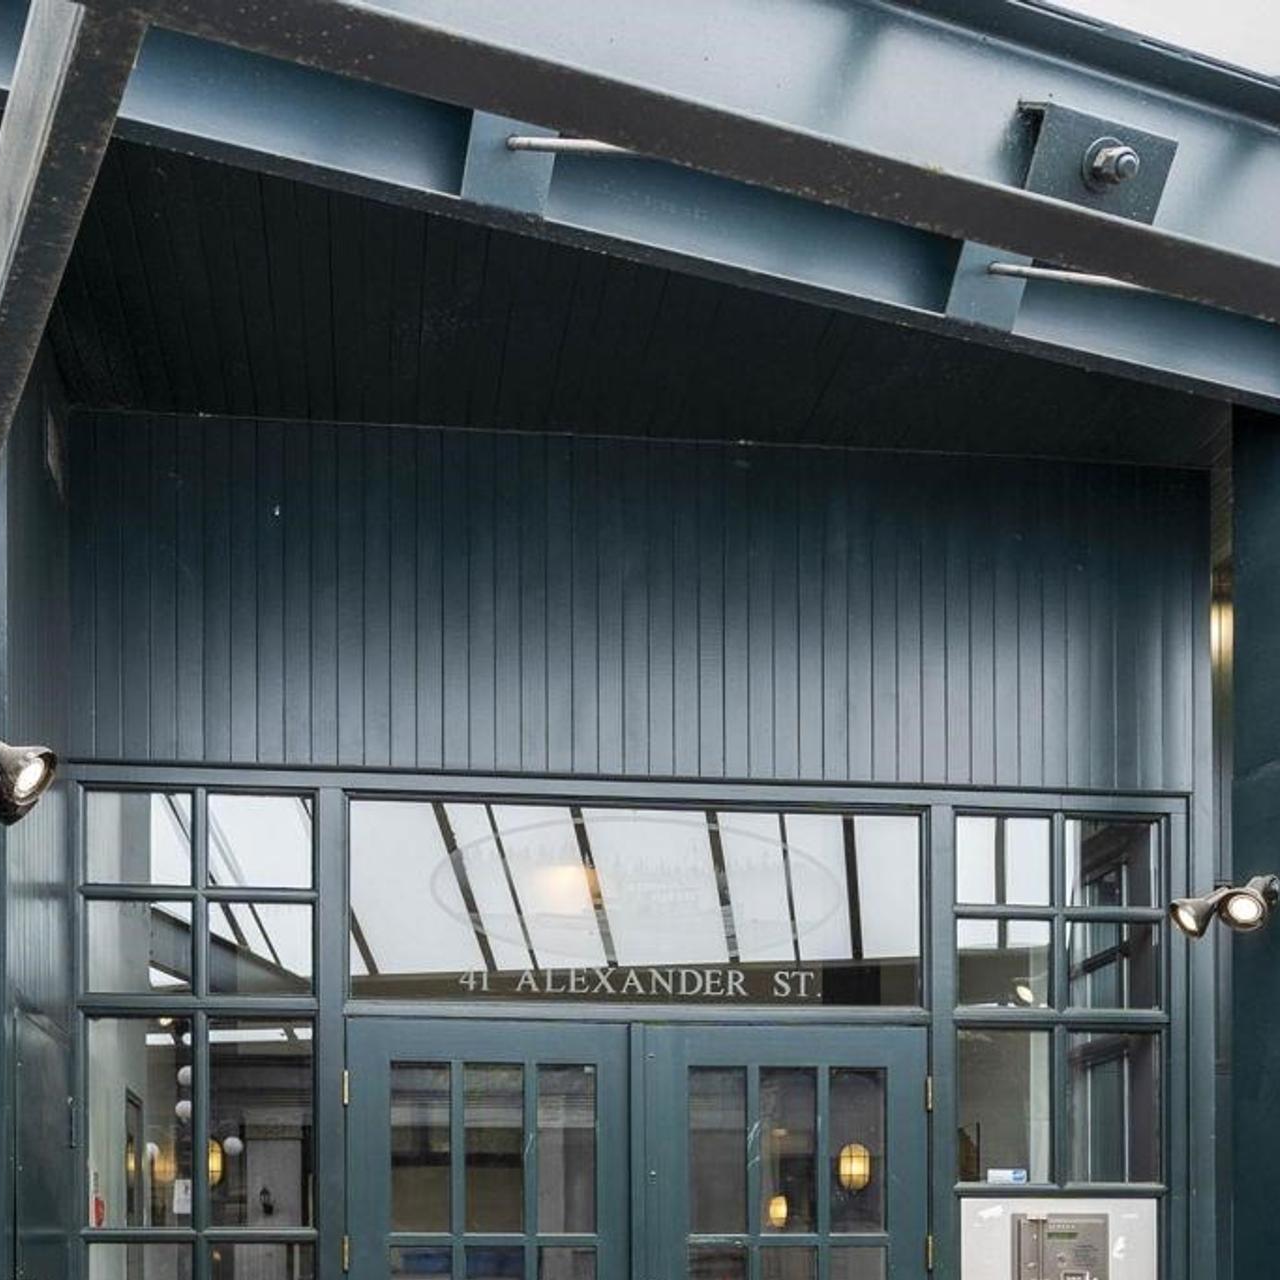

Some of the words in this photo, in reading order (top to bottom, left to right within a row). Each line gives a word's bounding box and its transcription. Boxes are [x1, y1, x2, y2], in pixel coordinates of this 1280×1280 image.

[459, 969, 491, 992] 41
[516, 967, 748, 997] ALEXANDER
[773, 971, 822, 998] ST.
